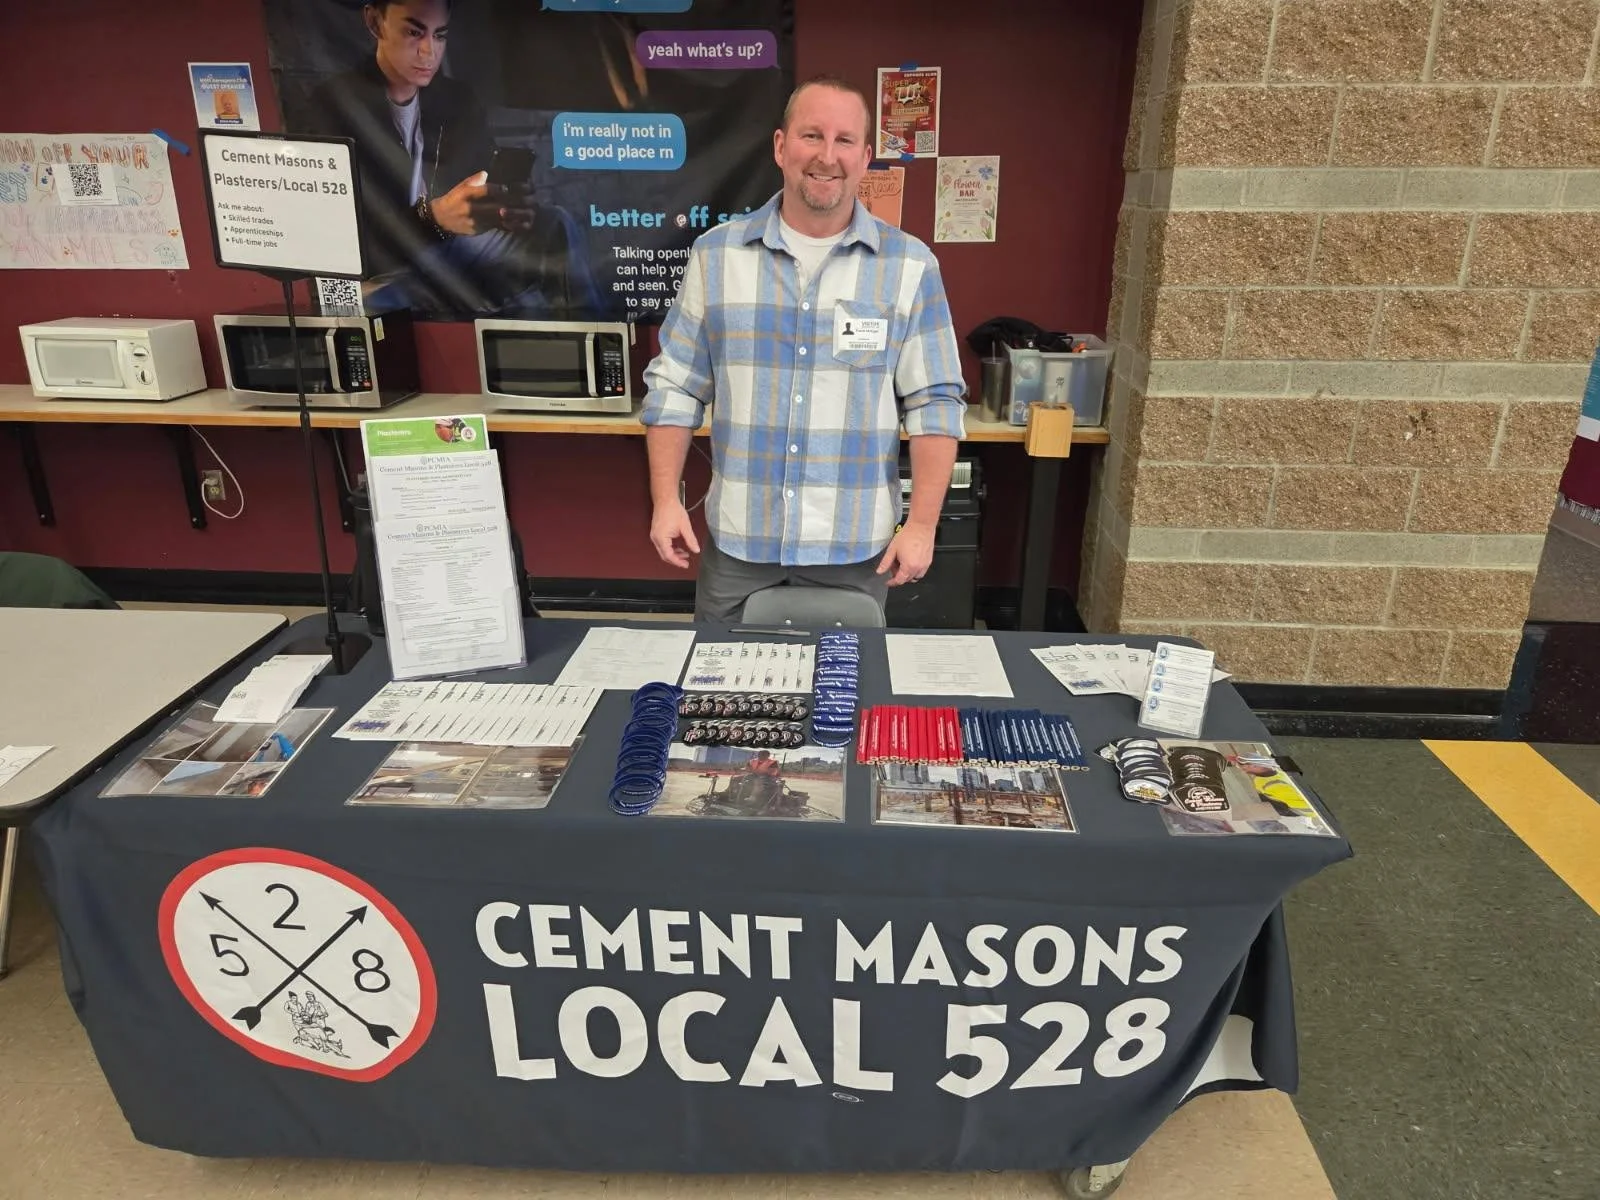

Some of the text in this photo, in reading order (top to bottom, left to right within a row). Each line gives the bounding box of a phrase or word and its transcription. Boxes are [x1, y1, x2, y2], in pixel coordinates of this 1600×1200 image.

[647, 42, 763, 60] yeah what's up?
[564, 123, 672, 141] i'm really not in
[221, 149, 337, 170] Cement Masons &
[564, 145, 674, 161] a good place rn
[214, 173, 348, 195] Plasterers/Local 528
[217, 202, 229, 210] Ask
[243, 204, 265, 213] about:
[590, 204, 665, 227] better
[228, 214, 274, 225] Skilled trades
[230, 226, 284, 238] Apprenticeships
[231, 236, 278, 248] Full-time jobs
[612, 246, 690, 261] Talking openl
[617, 263, 686, 277] can help yo
[612, 279, 634, 291] and
[638, 281, 669, 291] seen.
[625, 297, 638, 307] to
[641, 298, 660, 310] say
[264, 883, 306, 931] 2
[475, 901, 1188, 988] CEMENT MASONS
[209, 934, 250, 977] 5
[352, 948, 391, 993] 8
[483, 983, 1170, 1098] LOCAL 528
